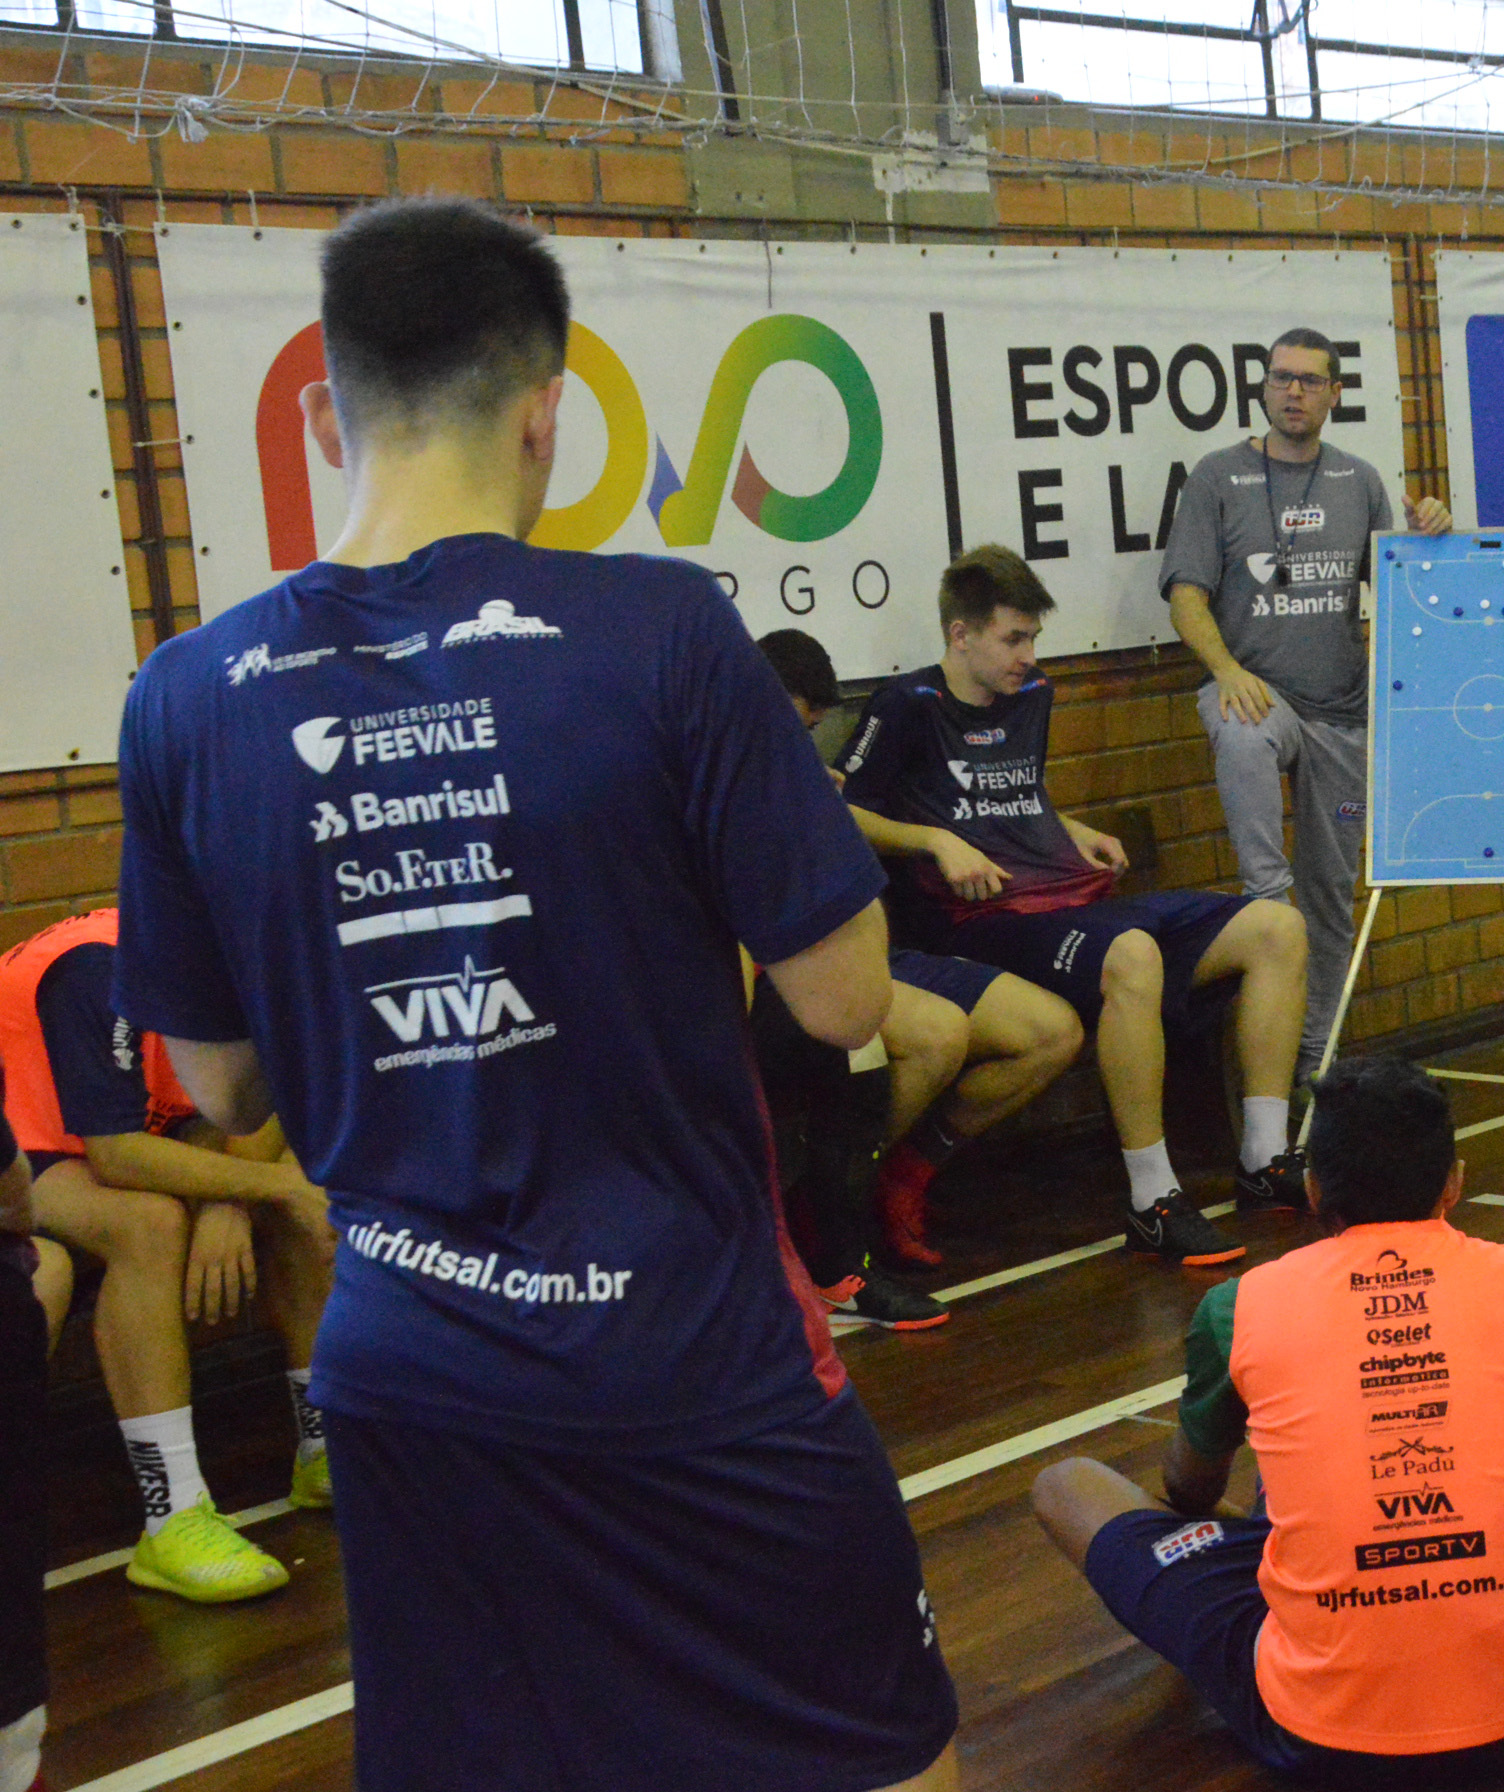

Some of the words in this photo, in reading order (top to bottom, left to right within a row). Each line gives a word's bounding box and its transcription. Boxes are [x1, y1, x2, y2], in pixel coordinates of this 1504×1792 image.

[1006, 340, 1367, 440] ESPORE
[1018, 468, 1070, 561] E
[350, 697, 492, 733] UNIVERSIDADE
[353, 716, 498, 766] FEEVALE
[351, 774, 511, 832] Banrisul
[370, 978, 536, 1043] VIVA
[1350, 1267, 1435, 1287] Brindes
[1364, 1290, 1429, 1316] JDM
[1360, 1351, 1446, 1373] chipbyte
[1371, 1464, 1396, 1480] Le
[1377, 1491, 1455, 1519] VIVA
[1364, 1537, 1478, 1565] SPORTV
